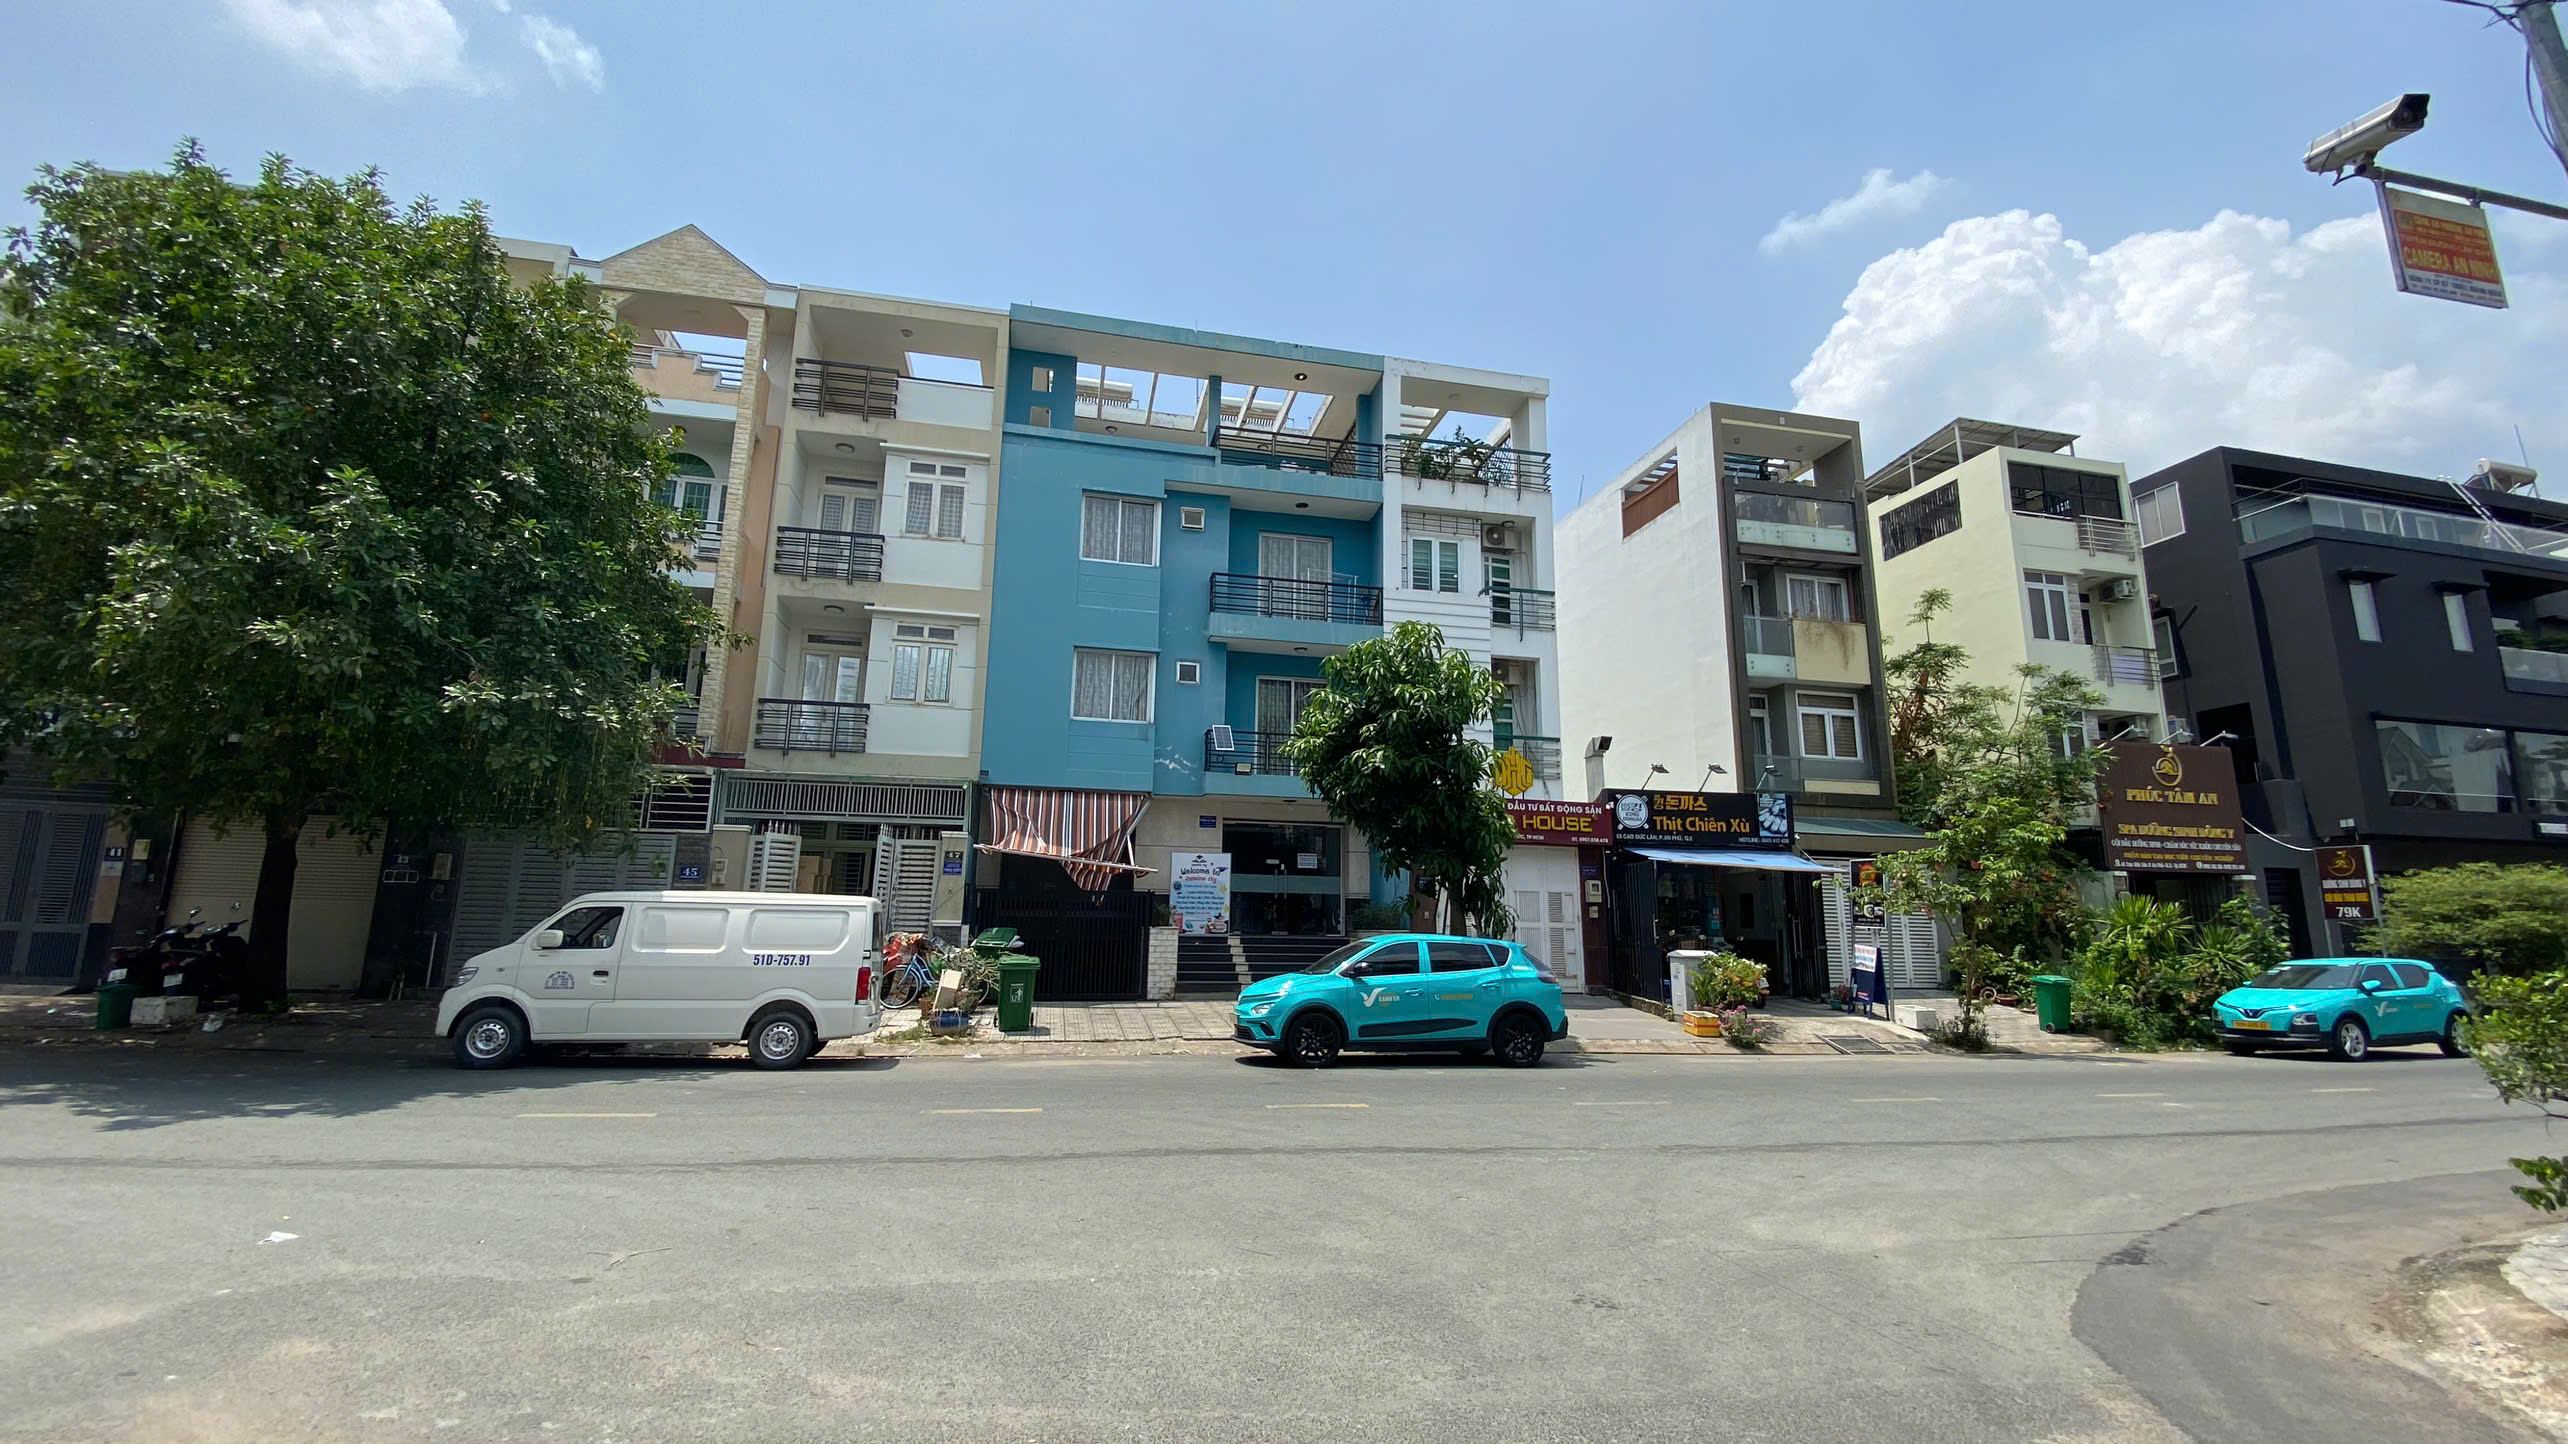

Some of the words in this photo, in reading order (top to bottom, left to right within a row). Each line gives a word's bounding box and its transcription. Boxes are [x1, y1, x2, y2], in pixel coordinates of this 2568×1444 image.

[2126, 786, 2164, 803] PHÚC
[2164, 788, 2196, 805] TÂM
[2199, 792, 2218, 805] AN
[1507, 800, 1526, 811] ĐẦU
[1527, 803, 1539, 811] TƯ
[1539, 801, 1555, 812] BẤT
[1557, 804, 1583, 815] ĐỘNG
[1585, 805, 1602, 815] SẢN
[1522, 815, 1593, 832] HOUSE
[1653, 816, 1682, 834] Thịt
[1685, 817, 1726, 832] Chiên
[1730, 818, 1750, 833] Xù
[682, 867, 699, 876] 45
[1181, 867, 1209, 875] Welcome
[1213, 868, 1221, 876] to
[2335, 906, 2363, 918] 79K
[753, 954, 811, 966] 51D-757.91
